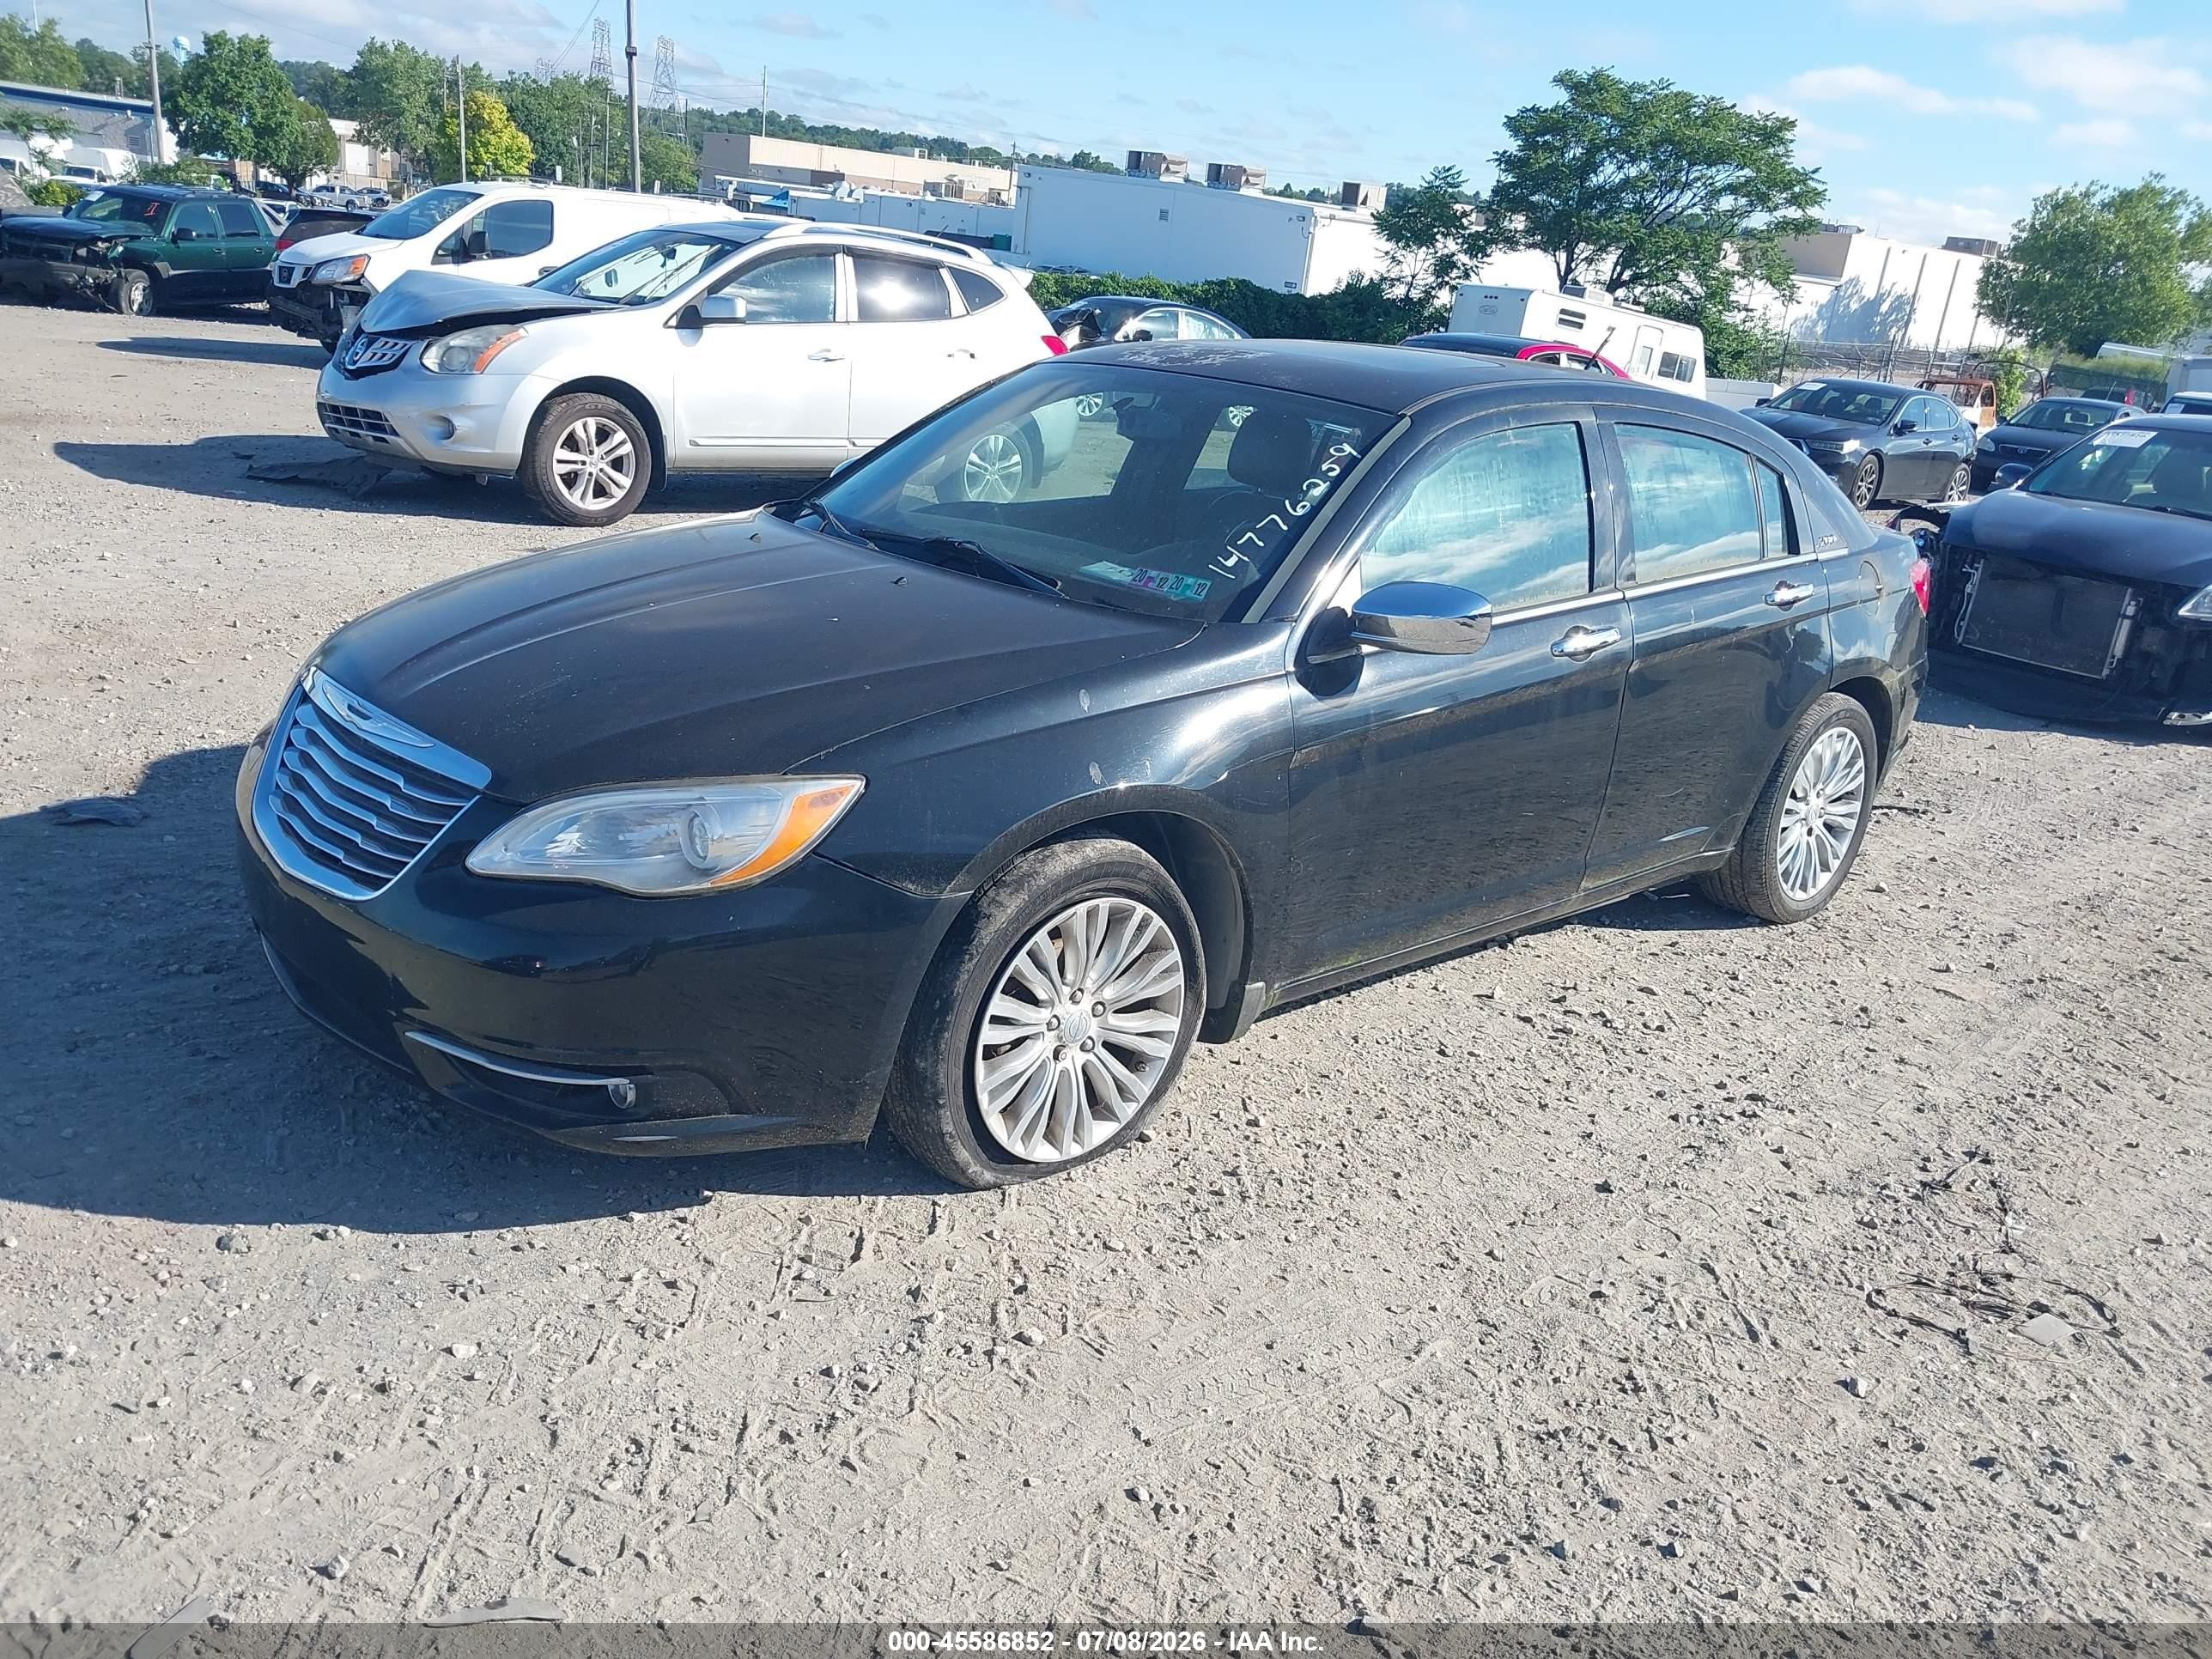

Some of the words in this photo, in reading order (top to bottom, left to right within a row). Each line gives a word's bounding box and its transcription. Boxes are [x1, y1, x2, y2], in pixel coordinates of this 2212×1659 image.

[1208, 443, 1362, 579] 14776259
[1133, 568, 1148, 583] 20
[1157, 576, 1170, 589] 12
[1169, 575, 1184, 591] 20
[1194, 582, 1207, 597] 12
